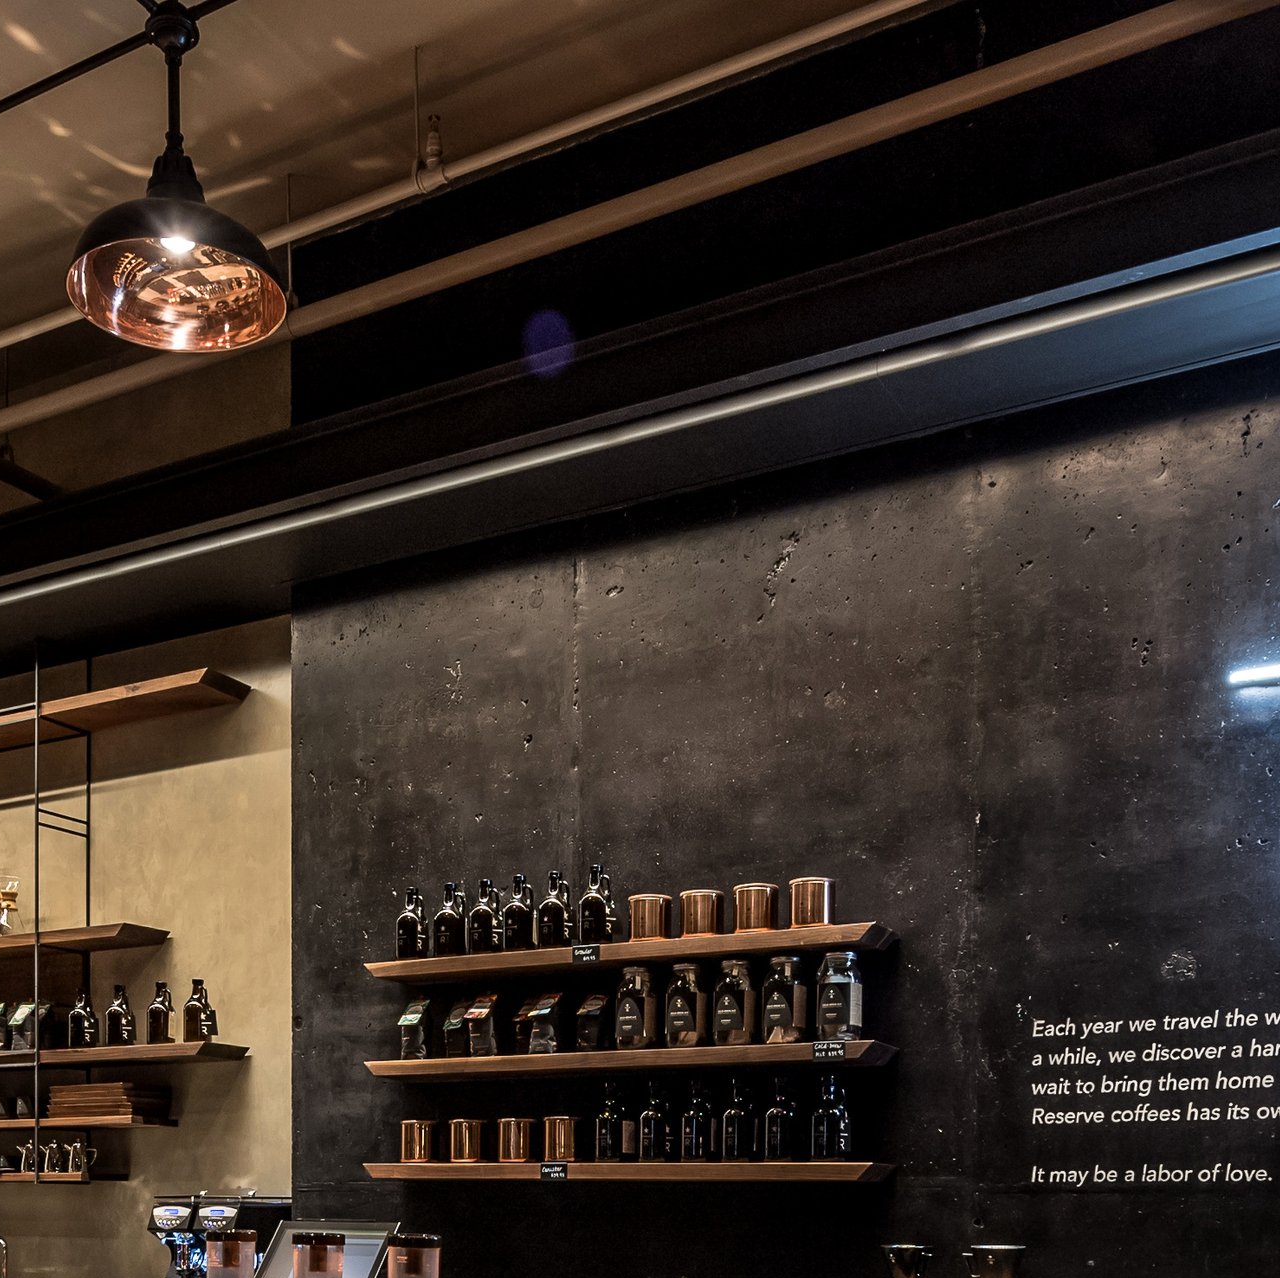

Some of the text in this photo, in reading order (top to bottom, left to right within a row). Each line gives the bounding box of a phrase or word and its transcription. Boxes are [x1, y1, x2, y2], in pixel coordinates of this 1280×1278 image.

[1032, 1017, 1076, 1038] Each
[1079, 1020, 1123, 1040] year
[1129, 1019, 1157, 1032] we
[1162, 1009, 1220, 1031] travel
[1225, 1008, 1259, 1028] the
[1031, 1054, 1043, 1067] a
[1048, 1046, 1102, 1066] while,
[1108, 1050, 1136, 1064] we
[1142, 1042, 1226, 1062] discover
[1231, 1044, 1243, 1058] a
[1031, 1078, 1071, 1095] wait
[1075, 1079, 1095, 1094] to
[1100, 1075, 1152, 1098] bring
[1158, 1072, 1210, 1091] them
[1215, 1071, 1275, 1090] home
[1031, 1108, 1105, 1125] Reserve
[1111, 1103, 1181, 1123] coffees
[1186, 1101, 1221, 1121] has
[1226, 1102, 1250, 1120] its
[1031, 1165, 1046, 1183] It
[1049, 1170, 1089, 1188] may
[1093, 1164, 1118, 1183] be
[1124, 1170, 1135, 1182] a
[1141, 1164, 1193, 1183] labor
[1197, 1163, 1221, 1183] of
[1225, 1163, 1272, 1182] love.
